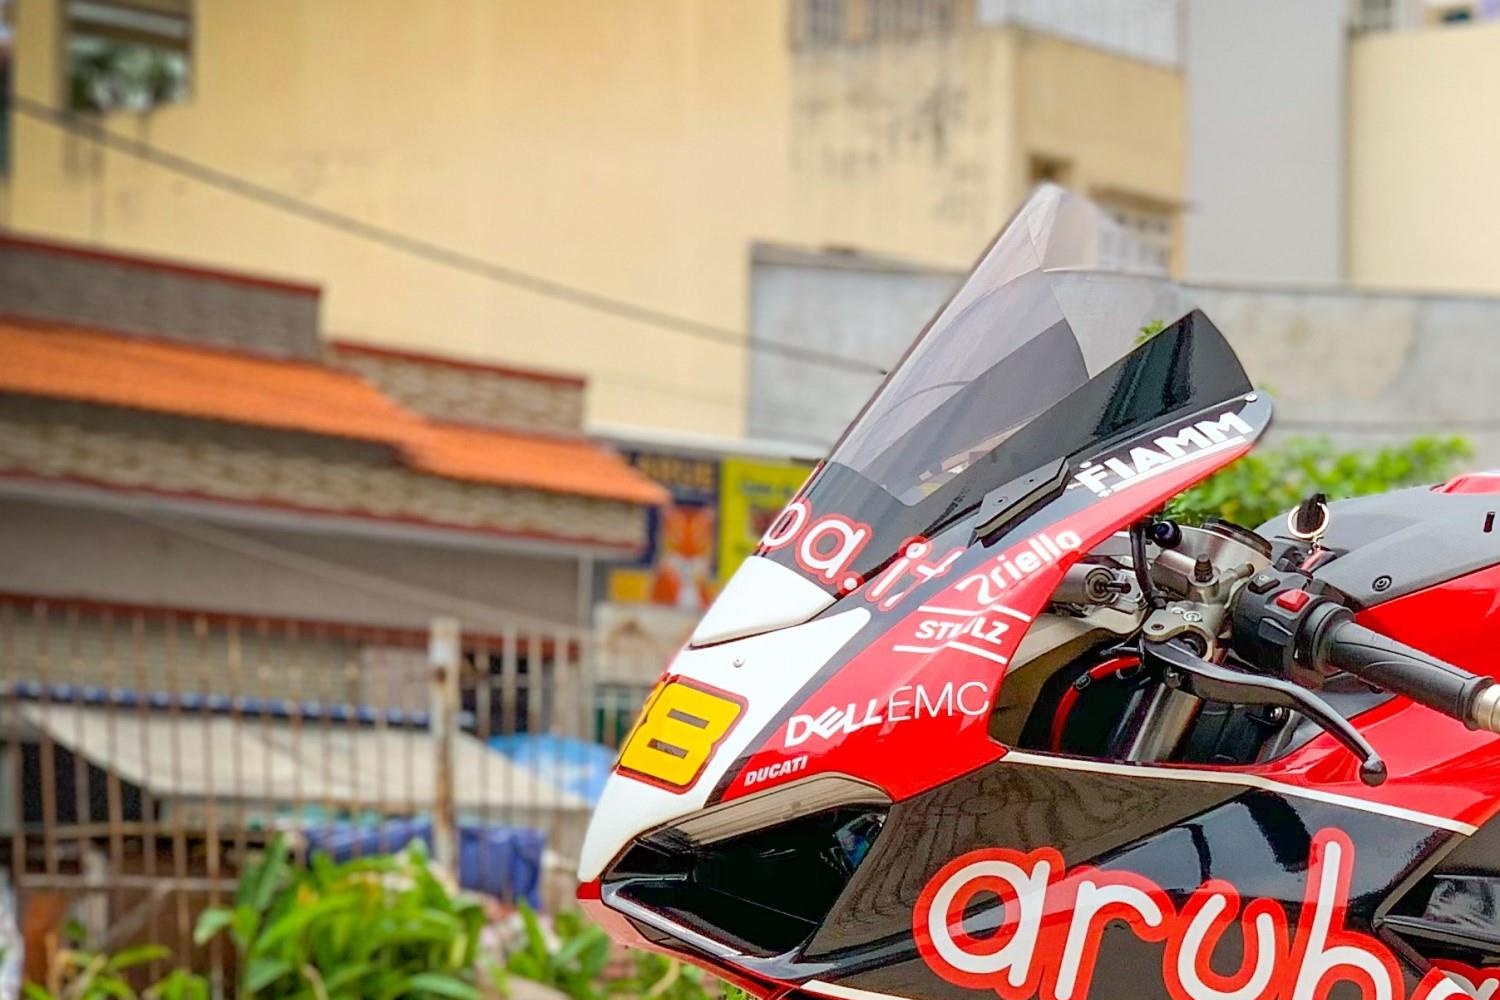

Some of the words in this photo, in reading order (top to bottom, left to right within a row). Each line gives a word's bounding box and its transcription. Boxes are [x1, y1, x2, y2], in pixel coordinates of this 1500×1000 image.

[1074, 411, 1254, 497] FIAMM
[915, 616, 1010, 645] STULZ
[744, 755, 808, 787] DUCATI
